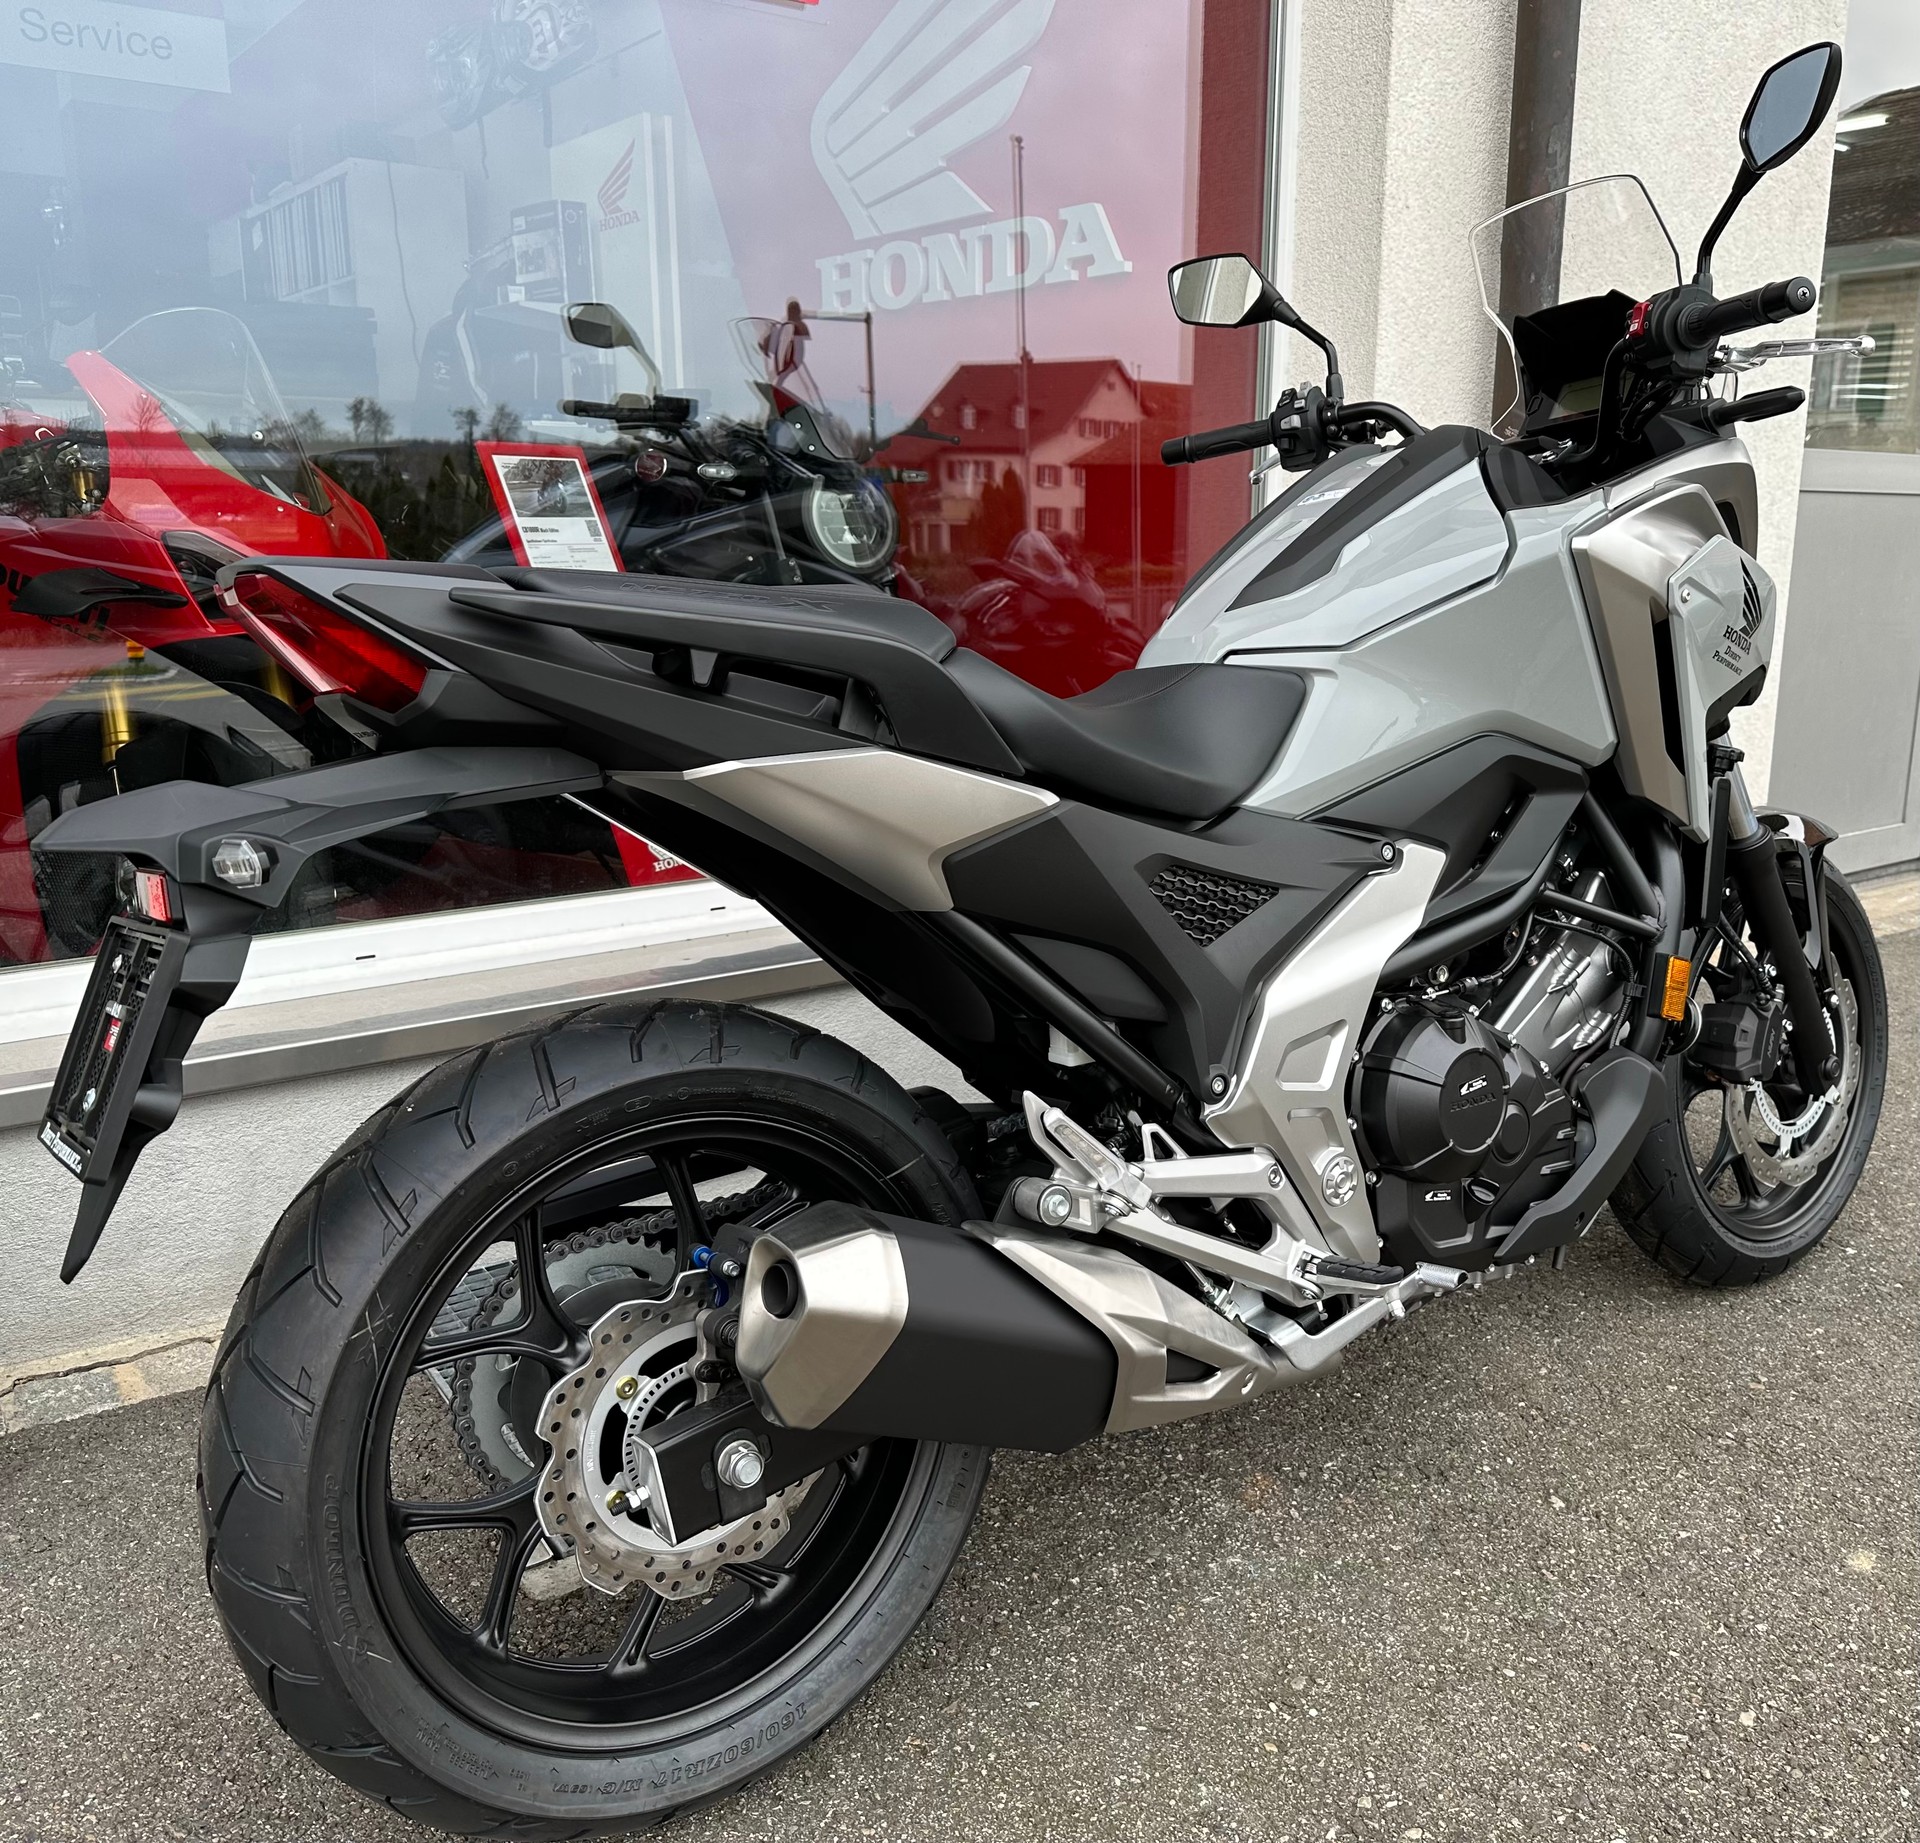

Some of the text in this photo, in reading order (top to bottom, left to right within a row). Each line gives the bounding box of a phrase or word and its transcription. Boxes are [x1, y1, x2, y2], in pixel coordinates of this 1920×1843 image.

[19, 7, 173, 60] Service
[599, 210, 640, 232] HONDA
[815, 202, 1133, 313] HONDA
[1722, 624, 1752, 656] HONDA
[653, 858, 682, 873] HON
[1450, 1093, 1496, 1112] HONDA
[323, 1473, 361, 1630] DUNLOP
[653, 1701, 807, 1789] 160/60ZR17
[602, 1778, 643, 1795] M/C
